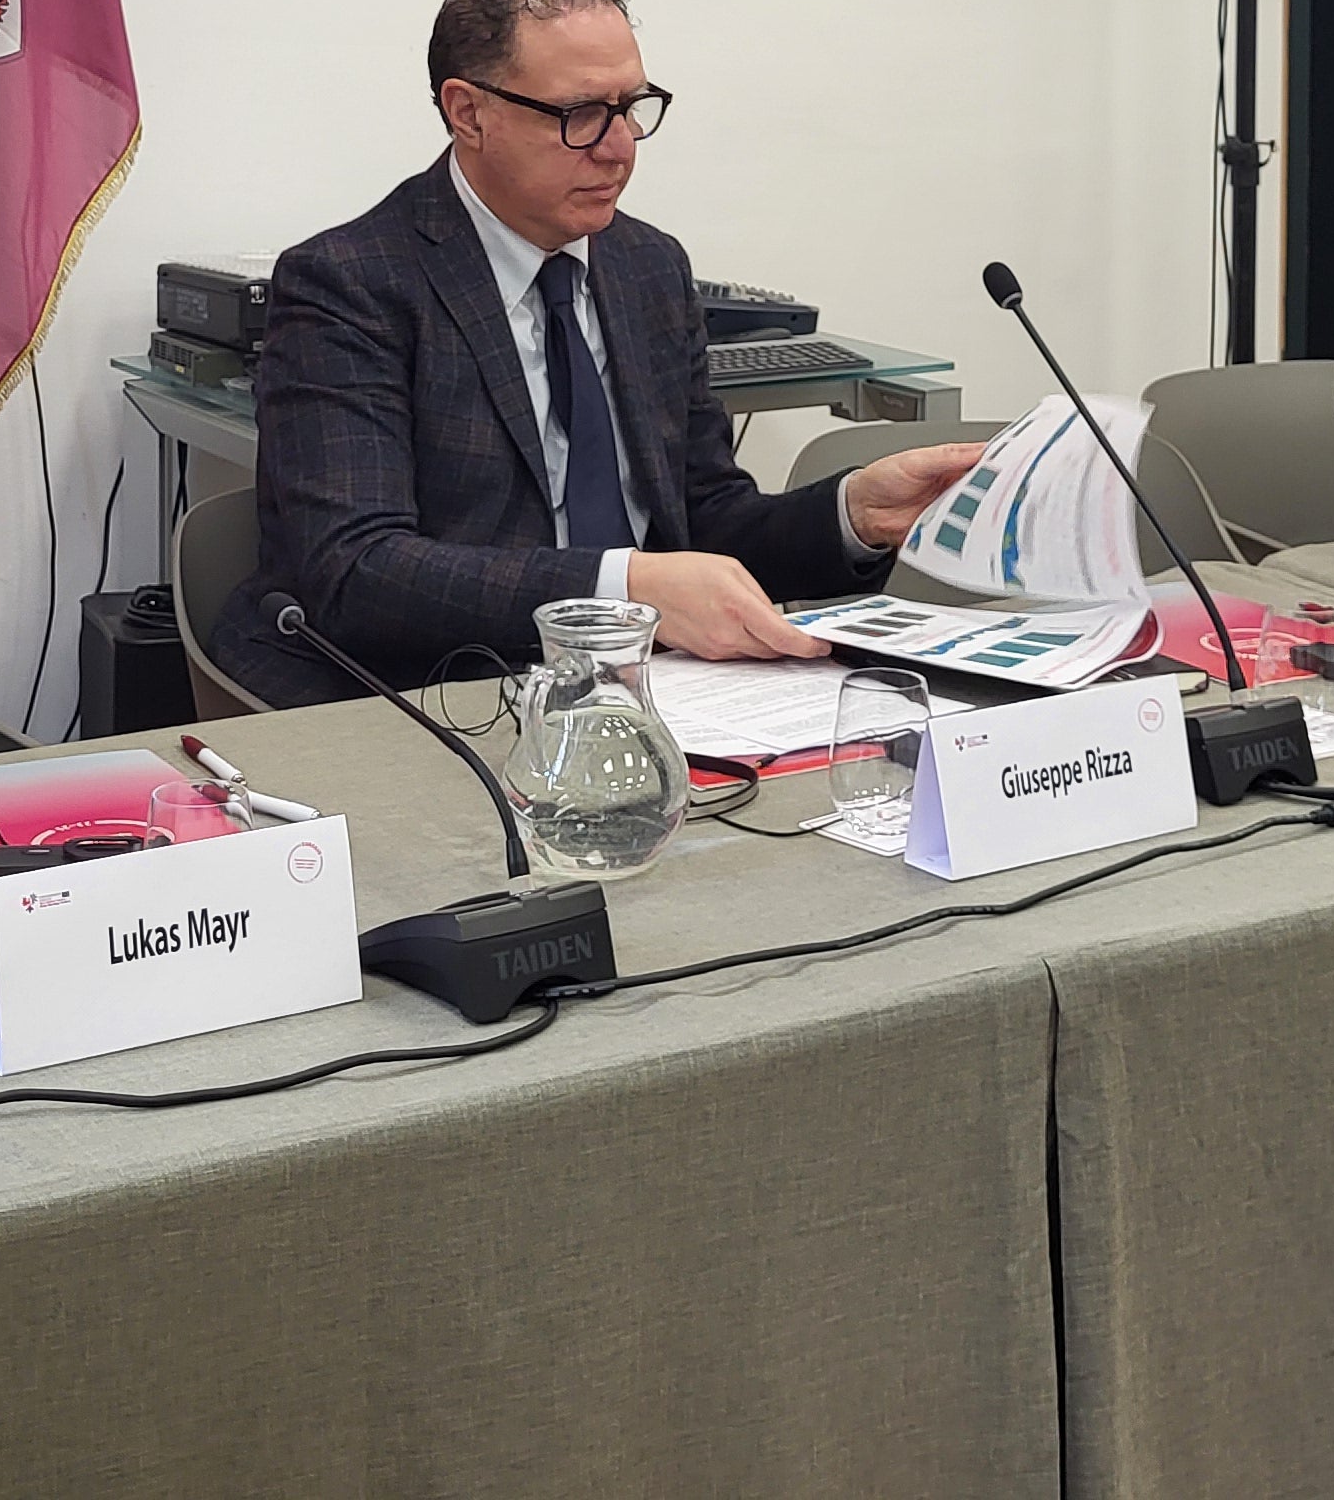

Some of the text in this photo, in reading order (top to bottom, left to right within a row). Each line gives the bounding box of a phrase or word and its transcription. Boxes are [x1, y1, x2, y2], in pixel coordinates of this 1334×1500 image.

[1001, 746, 1134, 799] Giuseppe Rizza
[107, 906, 251, 966] Lukas Mayr
[491, 933, 594, 981] TAIDEN
